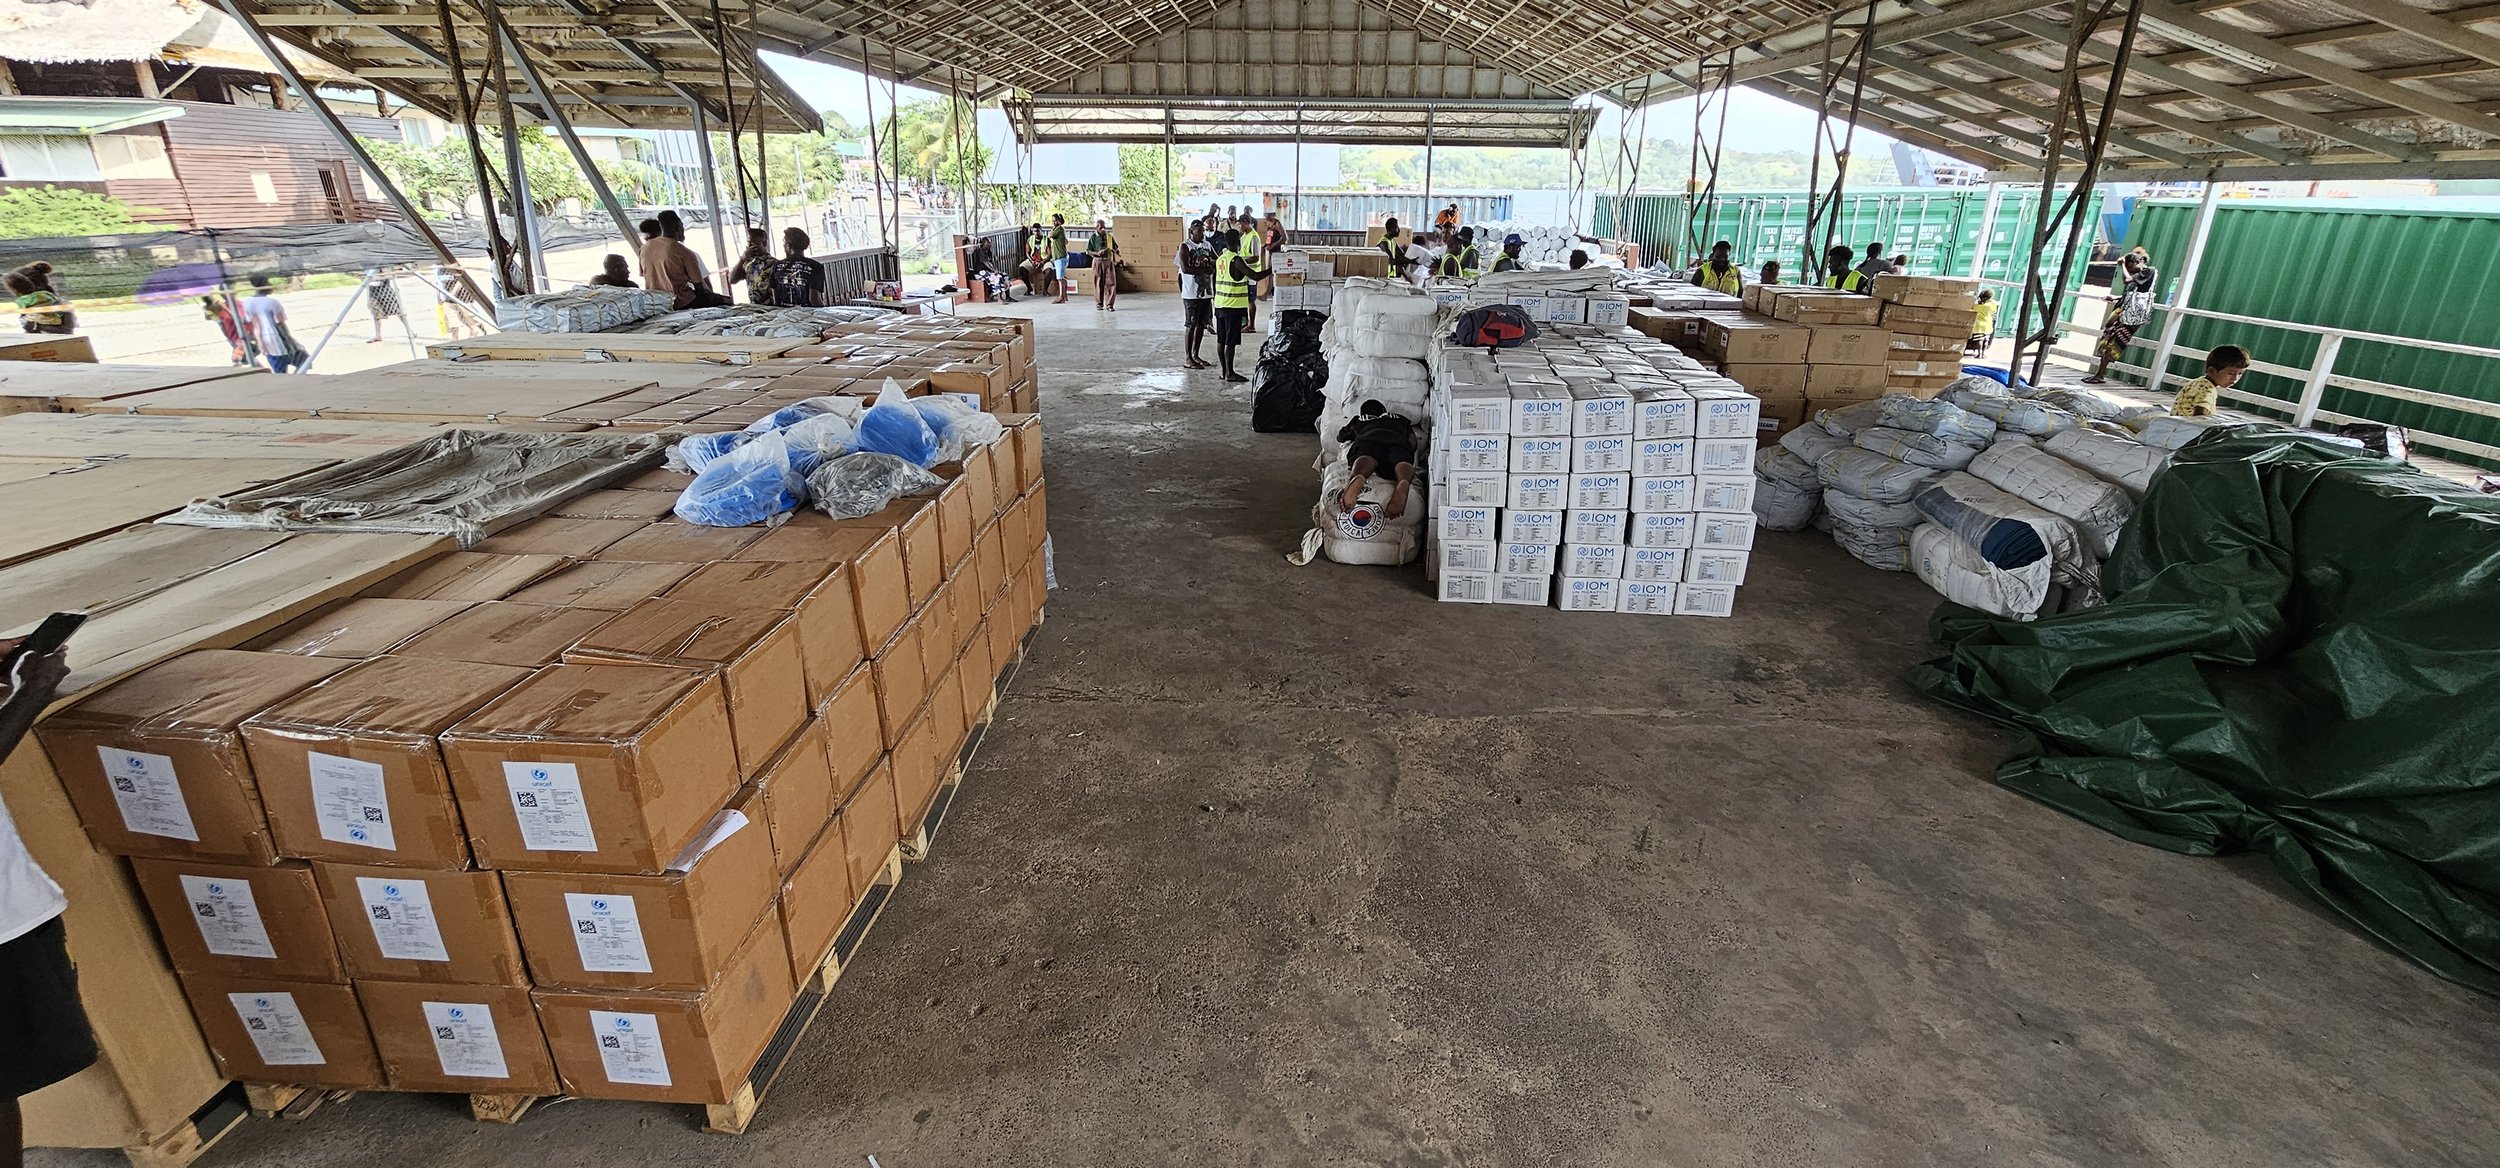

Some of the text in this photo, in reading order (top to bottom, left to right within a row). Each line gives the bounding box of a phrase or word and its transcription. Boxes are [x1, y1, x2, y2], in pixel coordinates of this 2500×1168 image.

[1537, 402, 1562, 412] IOM
[1600, 401, 1624, 411] IOM
[1660, 403, 1685, 414] IOM
[1725, 403, 1750, 413] IOM
[1474, 439, 1498, 448] IOM
[1537, 441, 1561, 451] IOM
[1599, 439, 1623, 449] IOM
[1658, 443, 1683, 453] IOM
[1534, 479, 1558, 488] IOM
[1594, 478, 1619, 487] IOM
[1660, 480, 1684, 490] IOM
[1462, 510, 1485, 519] IOM
[1528, 514, 1552, 523] IOM
[1592, 513, 1616, 523] IOM
[1660, 516, 1685, 526] IOM
[1523, 545, 1546, 554] IOM
[1591, 547, 1614, 556] IOM
[1650, 551, 1674, 560] IOM
[1586, 581, 1609, 590] IOM
[1642, 585, 1666, 594] IOM
